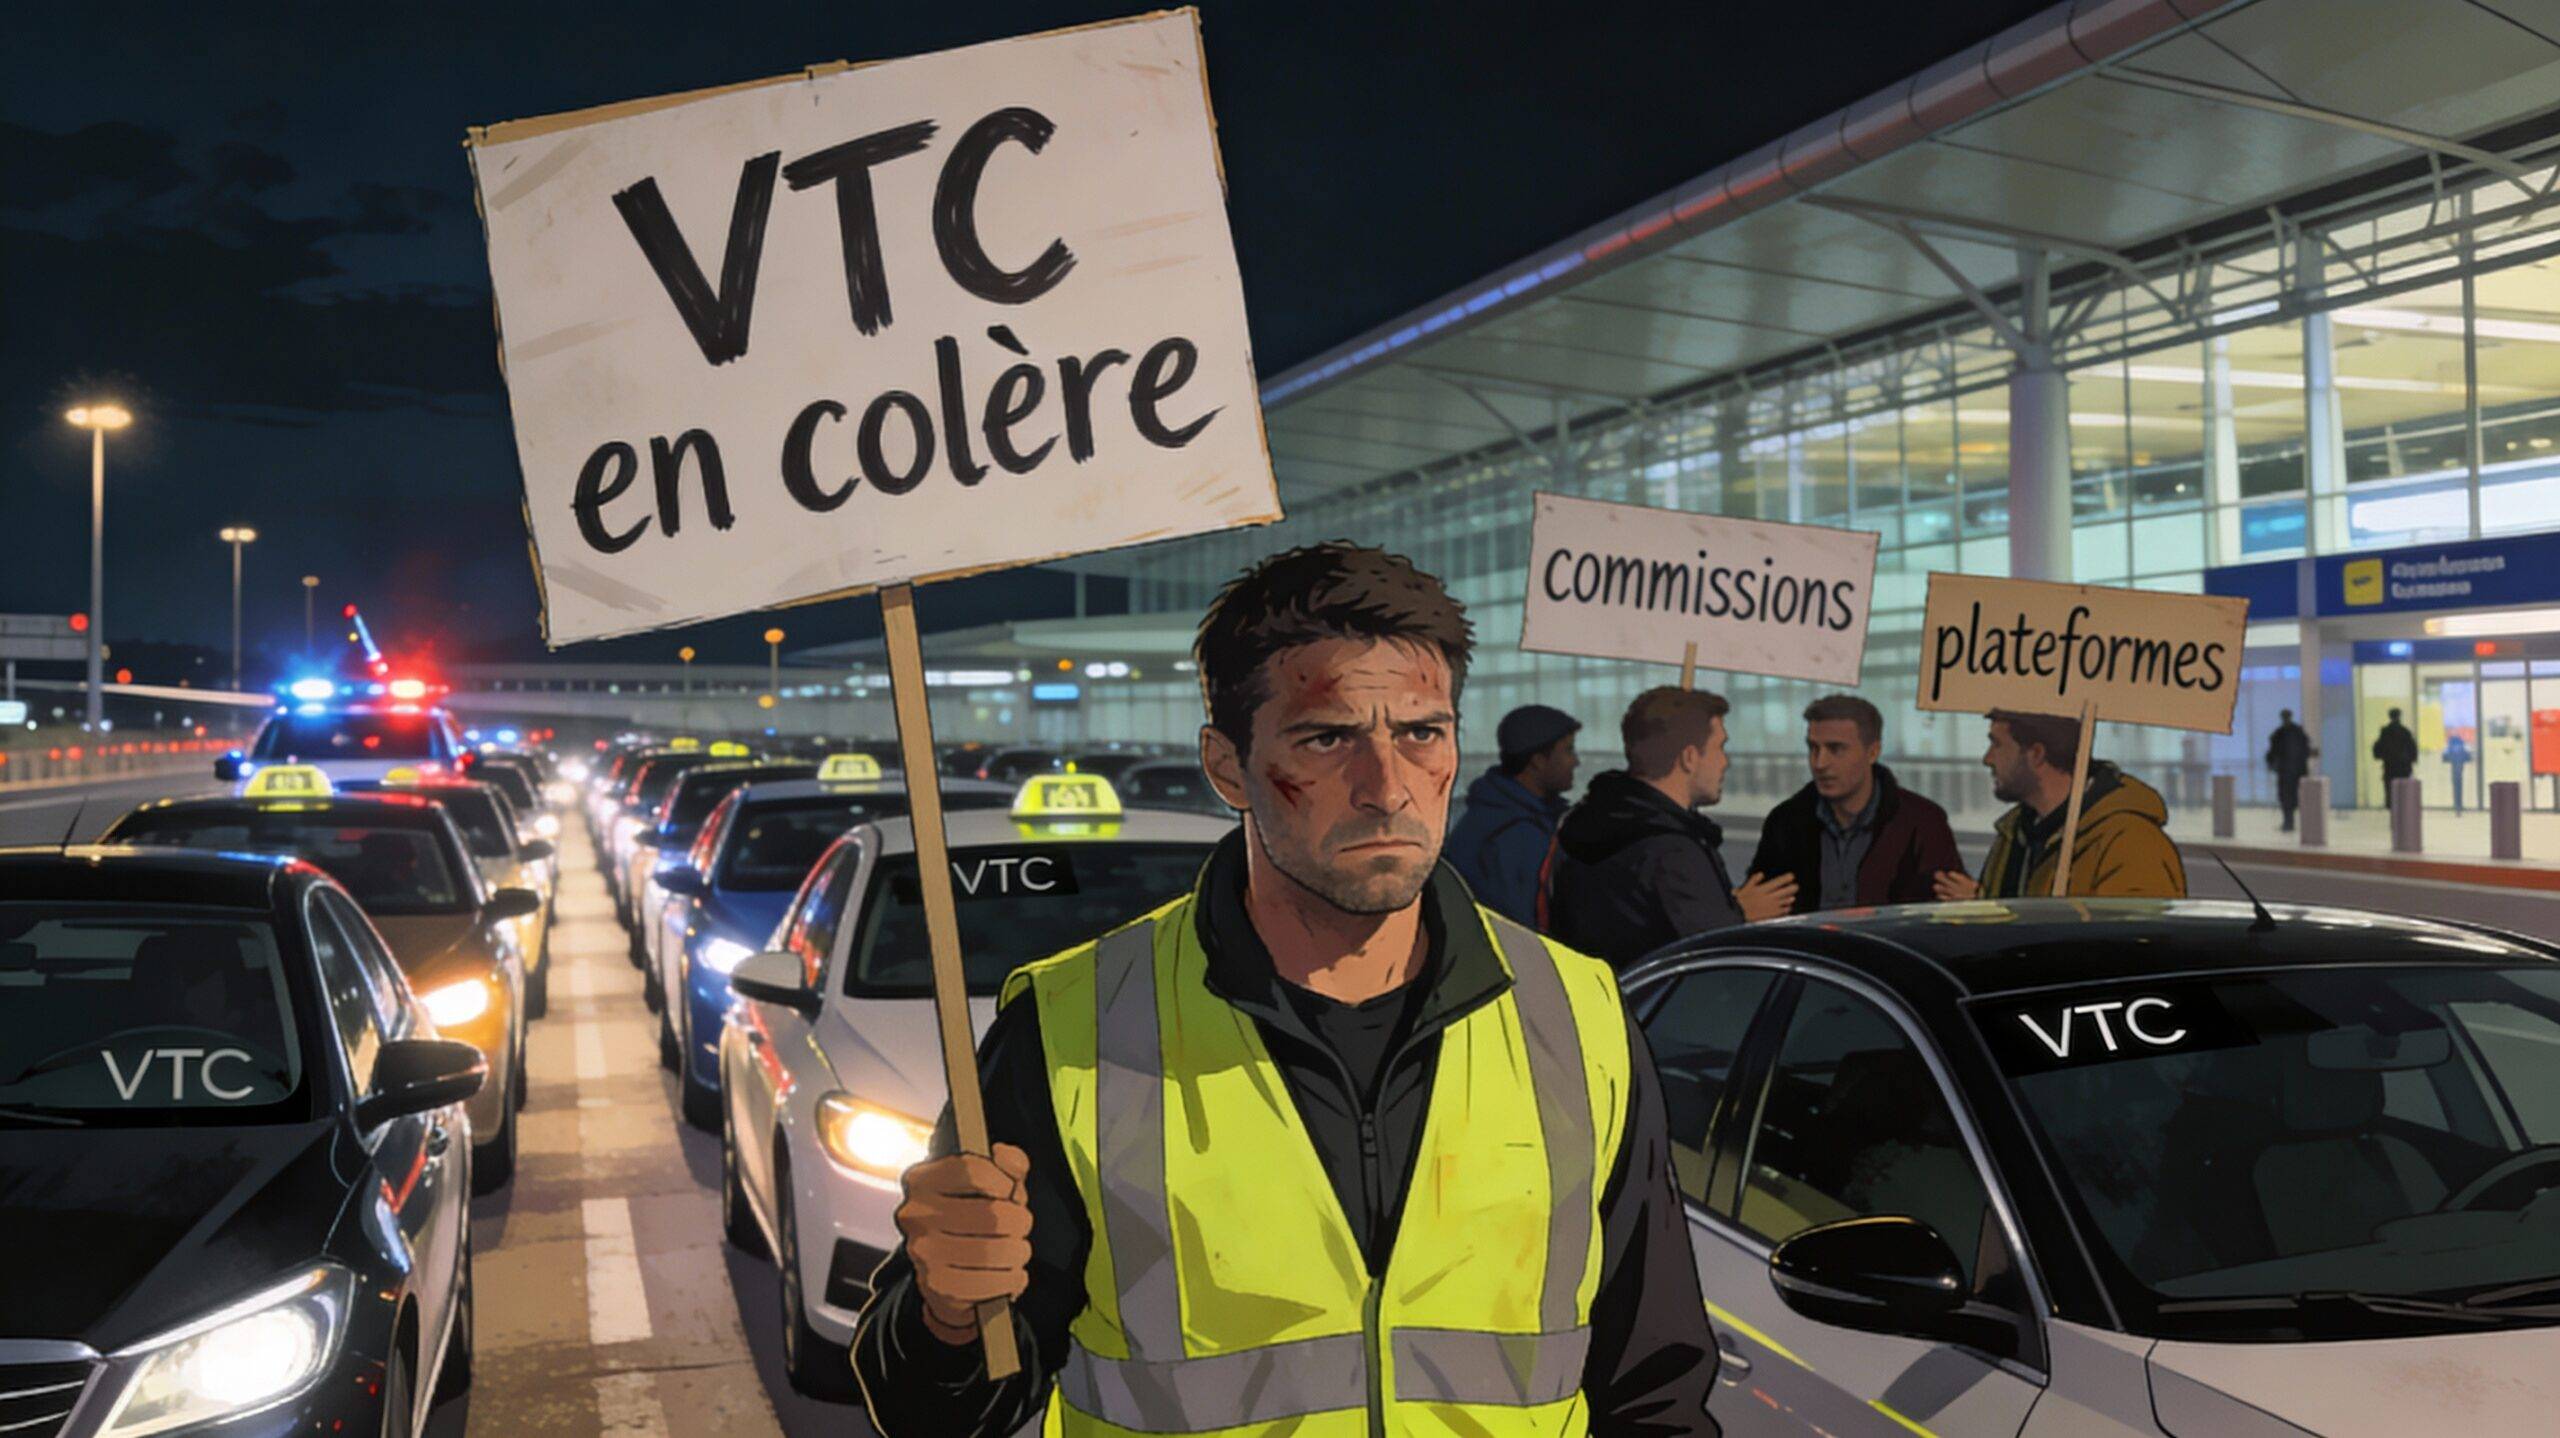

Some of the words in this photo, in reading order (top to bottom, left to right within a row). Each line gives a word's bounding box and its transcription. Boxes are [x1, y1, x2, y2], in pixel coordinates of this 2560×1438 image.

[612, 106, 1077, 367] VTC
[570, 428, 736, 555] en
[781, 324, 1228, 514] colère
[1543, 547, 1856, 632] commissions
[1930, 600, 2226, 703] plateformes
[951, 856, 1057, 896] VTC
[2017, 996, 2188, 1059] VTC
[101, 1048, 255, 1101] VTC
